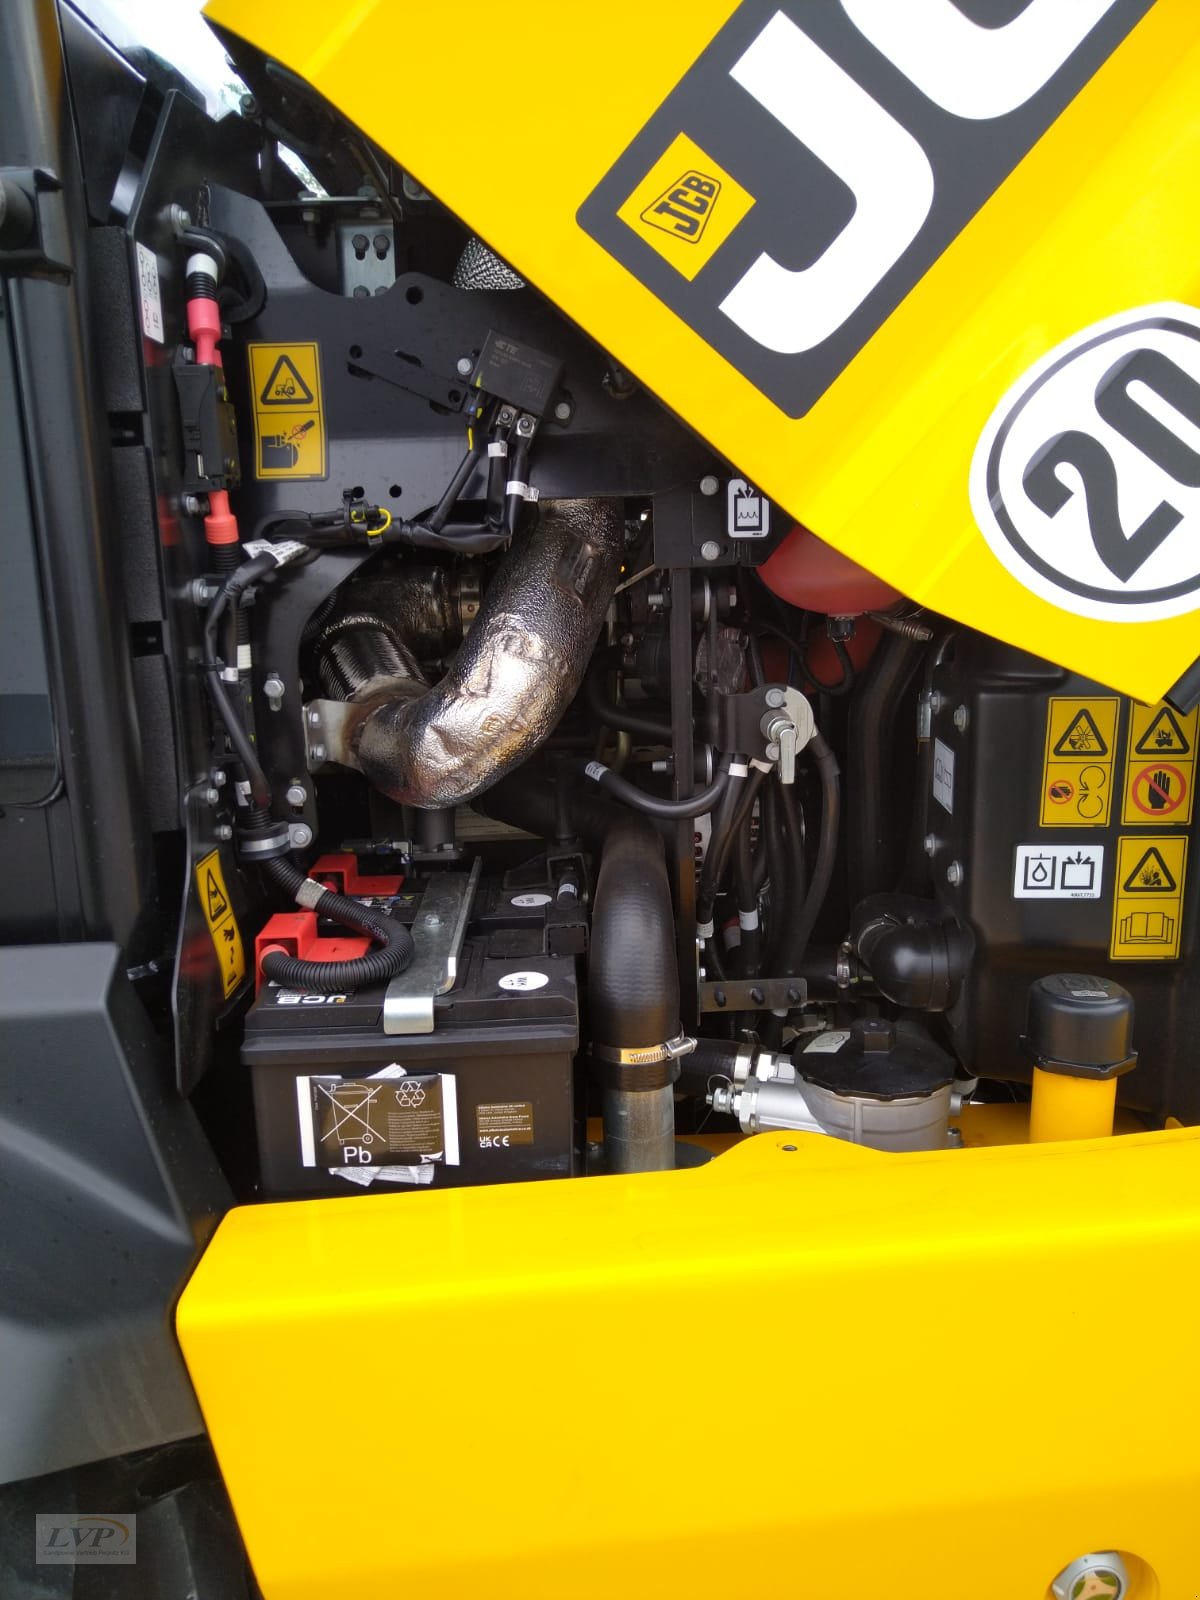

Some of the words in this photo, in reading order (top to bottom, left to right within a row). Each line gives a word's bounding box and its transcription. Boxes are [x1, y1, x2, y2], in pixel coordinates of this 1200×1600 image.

[653, 176, 716, 236] JCB
[1022, 348, 1200, 584] 20
[277, 995, 346, 1004] JCB
[493, 1135, 510, 1147] CE
[344, 1146, 372, 1163] Pb
